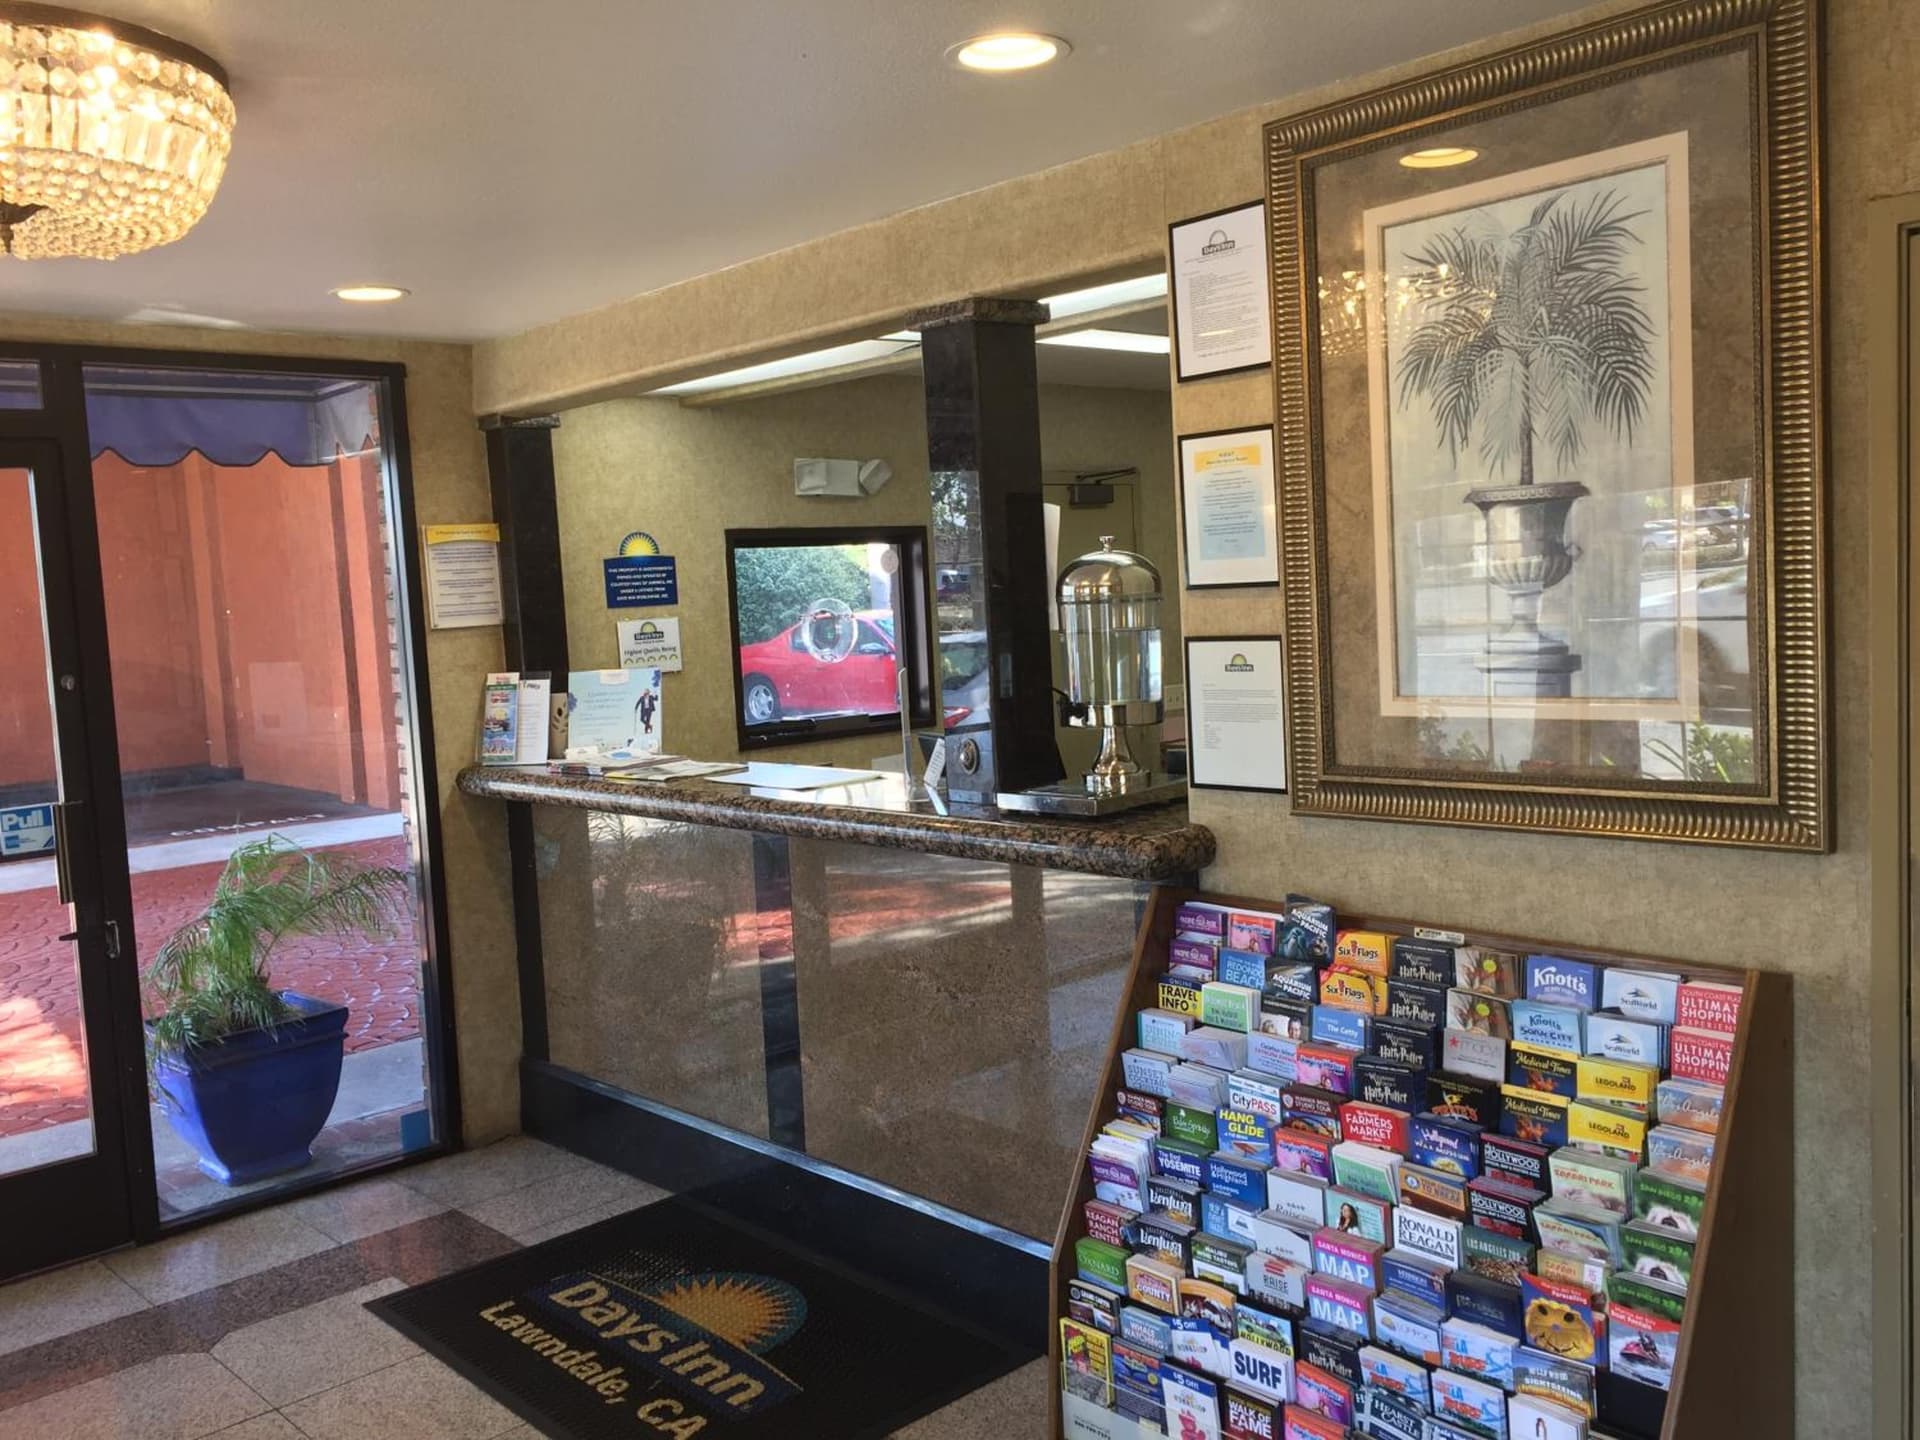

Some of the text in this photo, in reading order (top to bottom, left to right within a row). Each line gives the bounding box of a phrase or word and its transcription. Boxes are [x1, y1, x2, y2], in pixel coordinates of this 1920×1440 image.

[1291, 908, 1329, 932] AQUARIUM
[1300, 919, 1327, 938] PACIFIC
[1338, 946, 1378, 959] Six Flags
[1225, 969, 1264, 990] BEACH
[1273, 973, 1312, 992] AQUARIUM
[1534, 966, 1588, 995] Knott's
[1161, 985, 1198, 1002] TRAVEL
[1282, 983, 1311, 1000] PACIFIC
[1326, 984, 1365, 999] Six Flags
[1162, 996, 1189, 1011] INFO
[1682, 997, 1739, 1014] ULTIMAT
[1681, 1008, 1737, 1024] SHOPPIN
[1681, 1019, 1735, 1034] EXPERIEN
[1675, 1043, 1731, 1061] ULTIMAT
[1674, 1053, 1730, 1071] SHOPPIN
[1674, 1063, 1726, 1080] EXPERIEN
[1595, 1077, 1637, 1091] LEGOLAND
[1232, 1092, 1277, 1115] CityPASS
[1220, 1109, 1254, 1125] HANG
[1345, 1113, 1393, 1130] FARMERS
[1228, 1122, 1265, 1138] GLIDE
[1349, 1125, 1392, 1140] MARKET
[1589, 1122, 1630, 1139] LEGOLAND
[1158, 1157, 1201, 1177] YOSEMITE
[1485, 1146, 1540, 1170] HOLLYWOOD
[1150, 1188, 1192, 1219] Ventura
[1472, 1194, 1526, 1220] HOLLYWOOD
[1086, 1210, 1119, 1227] REAGAN
[1088, 1221, 1118, 1236] RANCH
[1399, 1215, 1454, 1242] RONALD
[1089, 1229, 1121, 1247] CENTER
[1140, 1228, 1182, 1258] Ventura
[1399, 1231, 1454, 1255] REAGAN
[1317, 1241, 1367, 1262] SANTA MONICA
[1319, 1252, 1369, 1285] MAP
[1264, 1275, 1289, 1289] RAISE
[1136, 1284, 1171, 1302] COUNTY
[1311, 1285, 1361, 1309] SANTA MONICA
[1313, 1296, 1363, 1331] MAP
[1172, 1318, 1184, 1330] $5
[548, 1279, 766, 1406] Days Inn
[479, 1300, 709, 1440] Lawndale, CA
[1172, 1372, 1184, 1384] $5
[1234, 1351, 1282, 1389] SURF
[1228, 1400, 1272, 1425] WALK OF
[1375, 1399, 1415, 1426] HEARST
[1230, 1412, 1272, 1440] FAME
[1381, 1411, 1418, 1438] CASTLE
